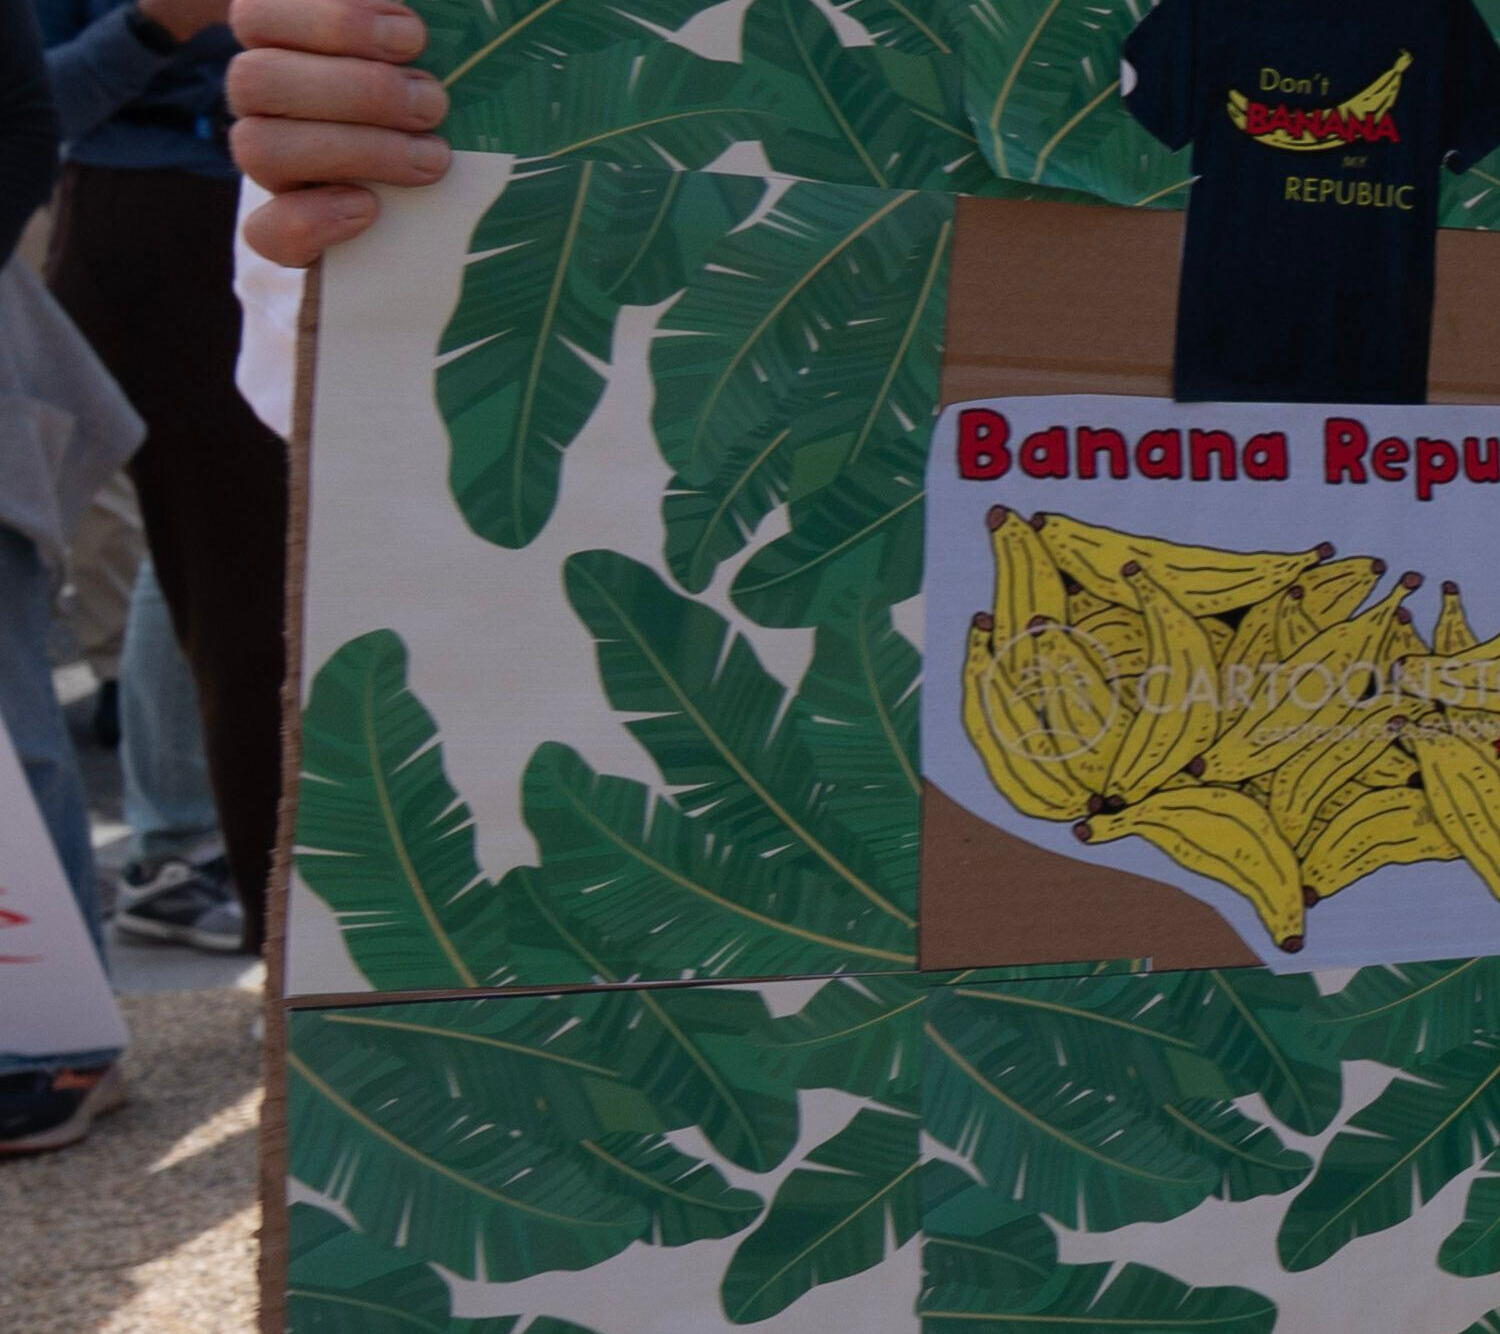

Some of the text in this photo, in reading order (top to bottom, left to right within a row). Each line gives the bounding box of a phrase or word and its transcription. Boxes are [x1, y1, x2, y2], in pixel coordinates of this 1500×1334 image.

[1258, 66, 1331, 97] Don't
[1246, 101, 1401, 145] BANANA
[1284, 175, 1417, 211] REPUBLIC
[955, 407, 1290, 483] Banana
